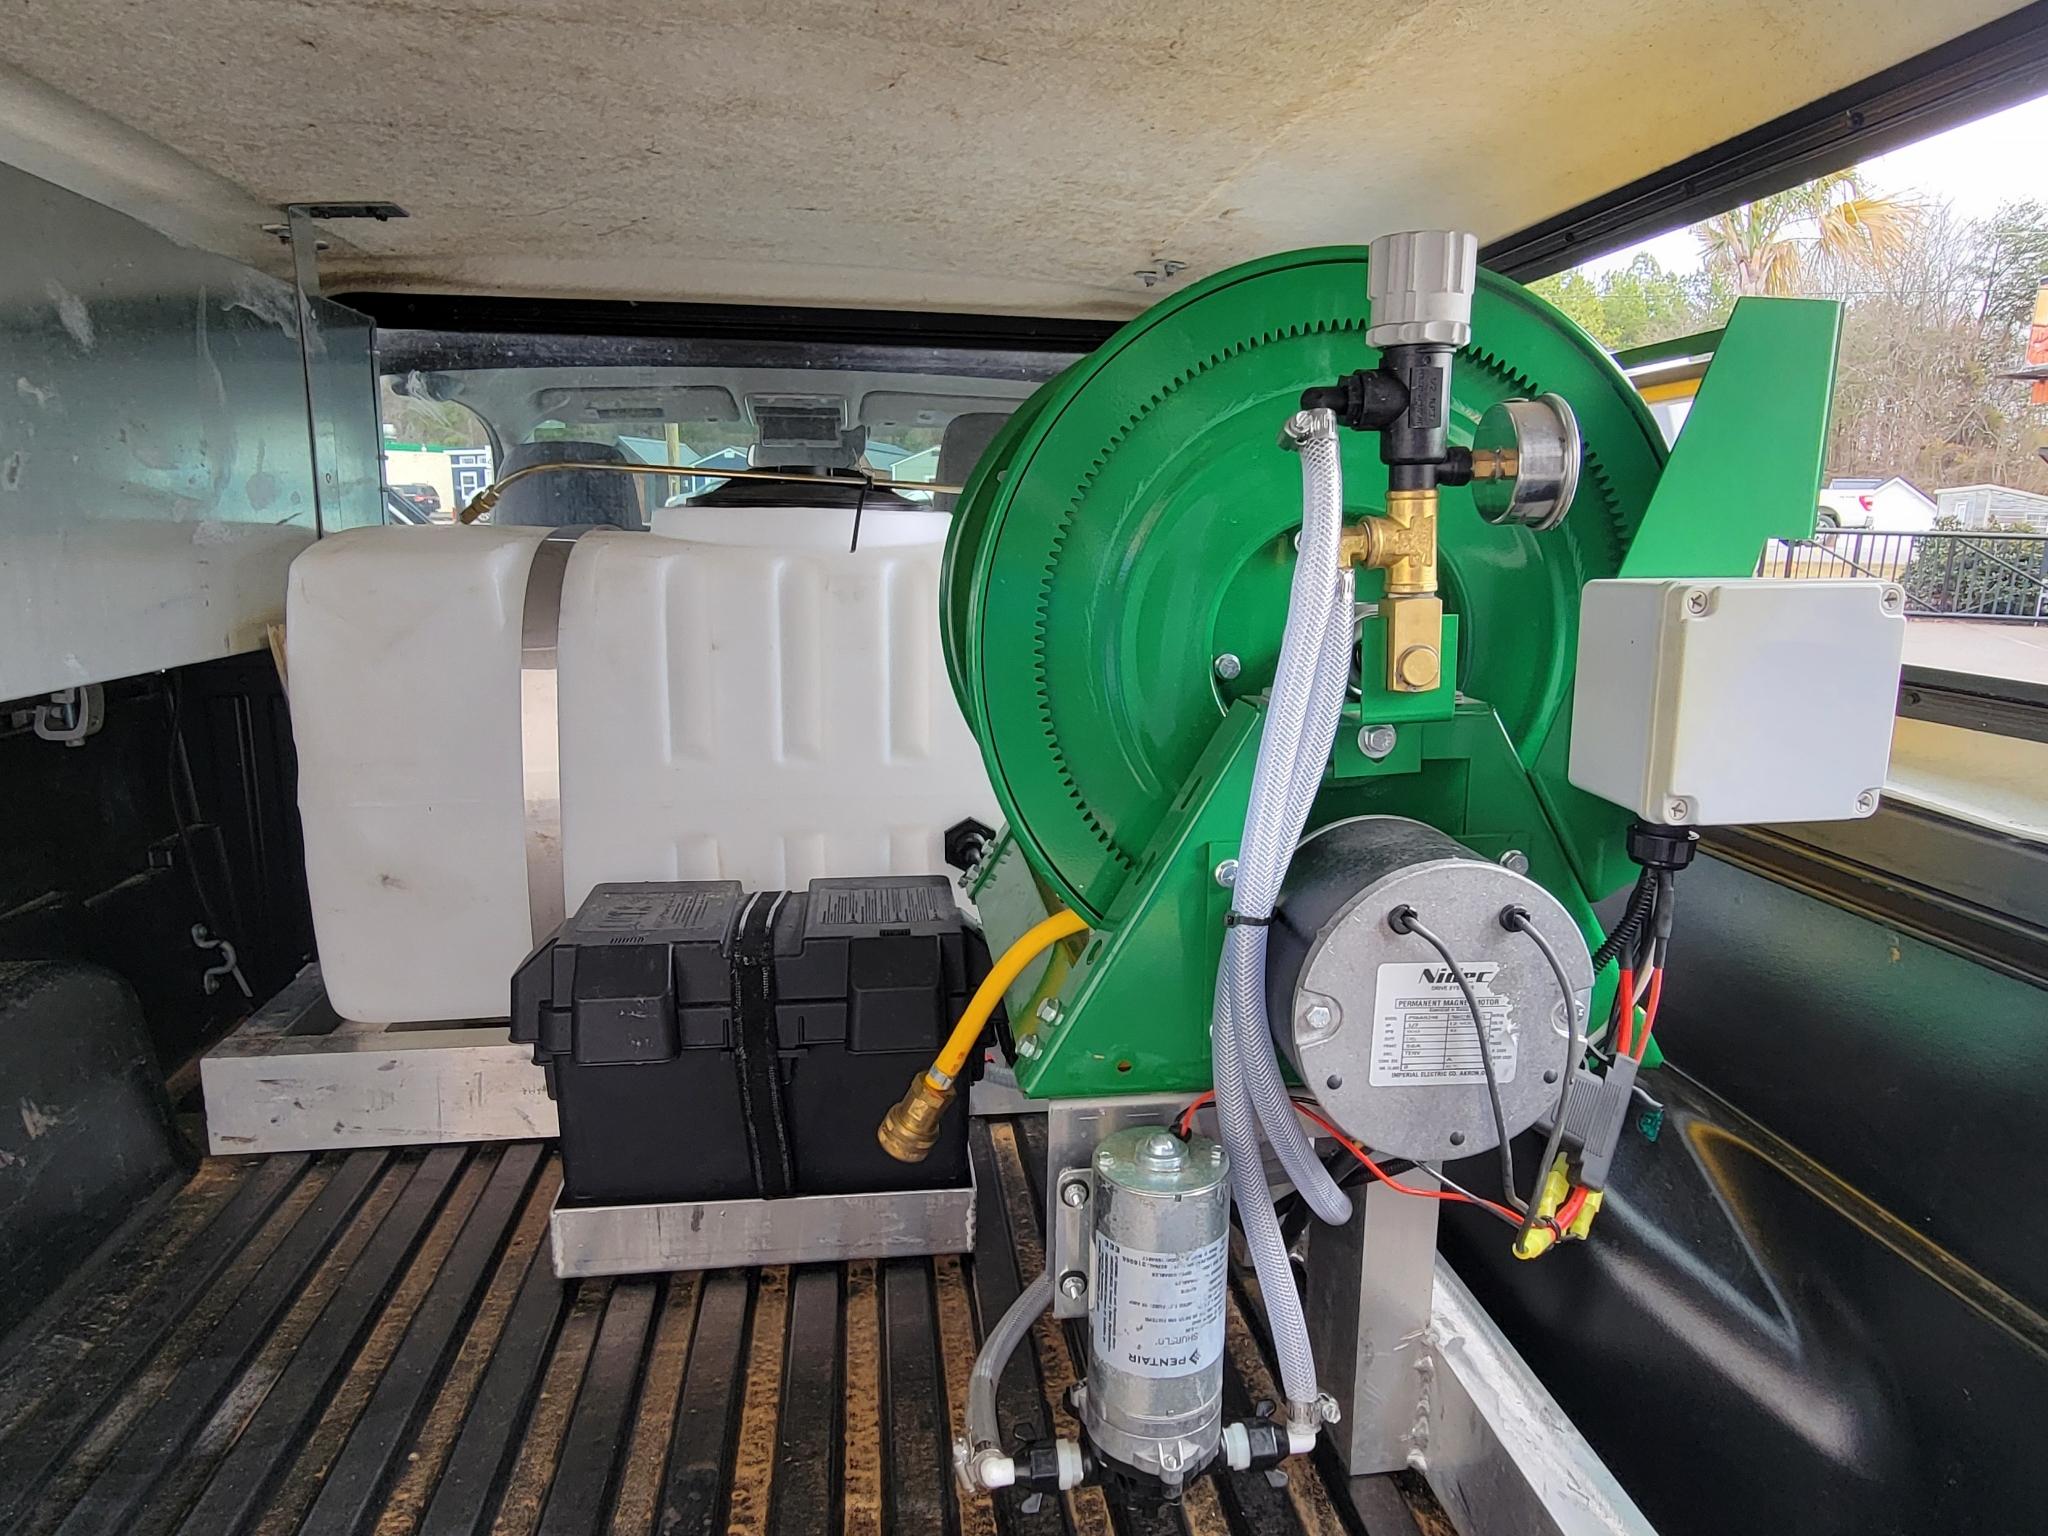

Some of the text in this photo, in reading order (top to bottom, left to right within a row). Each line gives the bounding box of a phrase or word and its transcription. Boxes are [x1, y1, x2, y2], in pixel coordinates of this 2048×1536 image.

[1398, 999, 1441, 1008] PERMANENT
[1443, 999, 1470, 1007] MAGNE
[1128, 1353, 1187, 1367] PENTAIR
